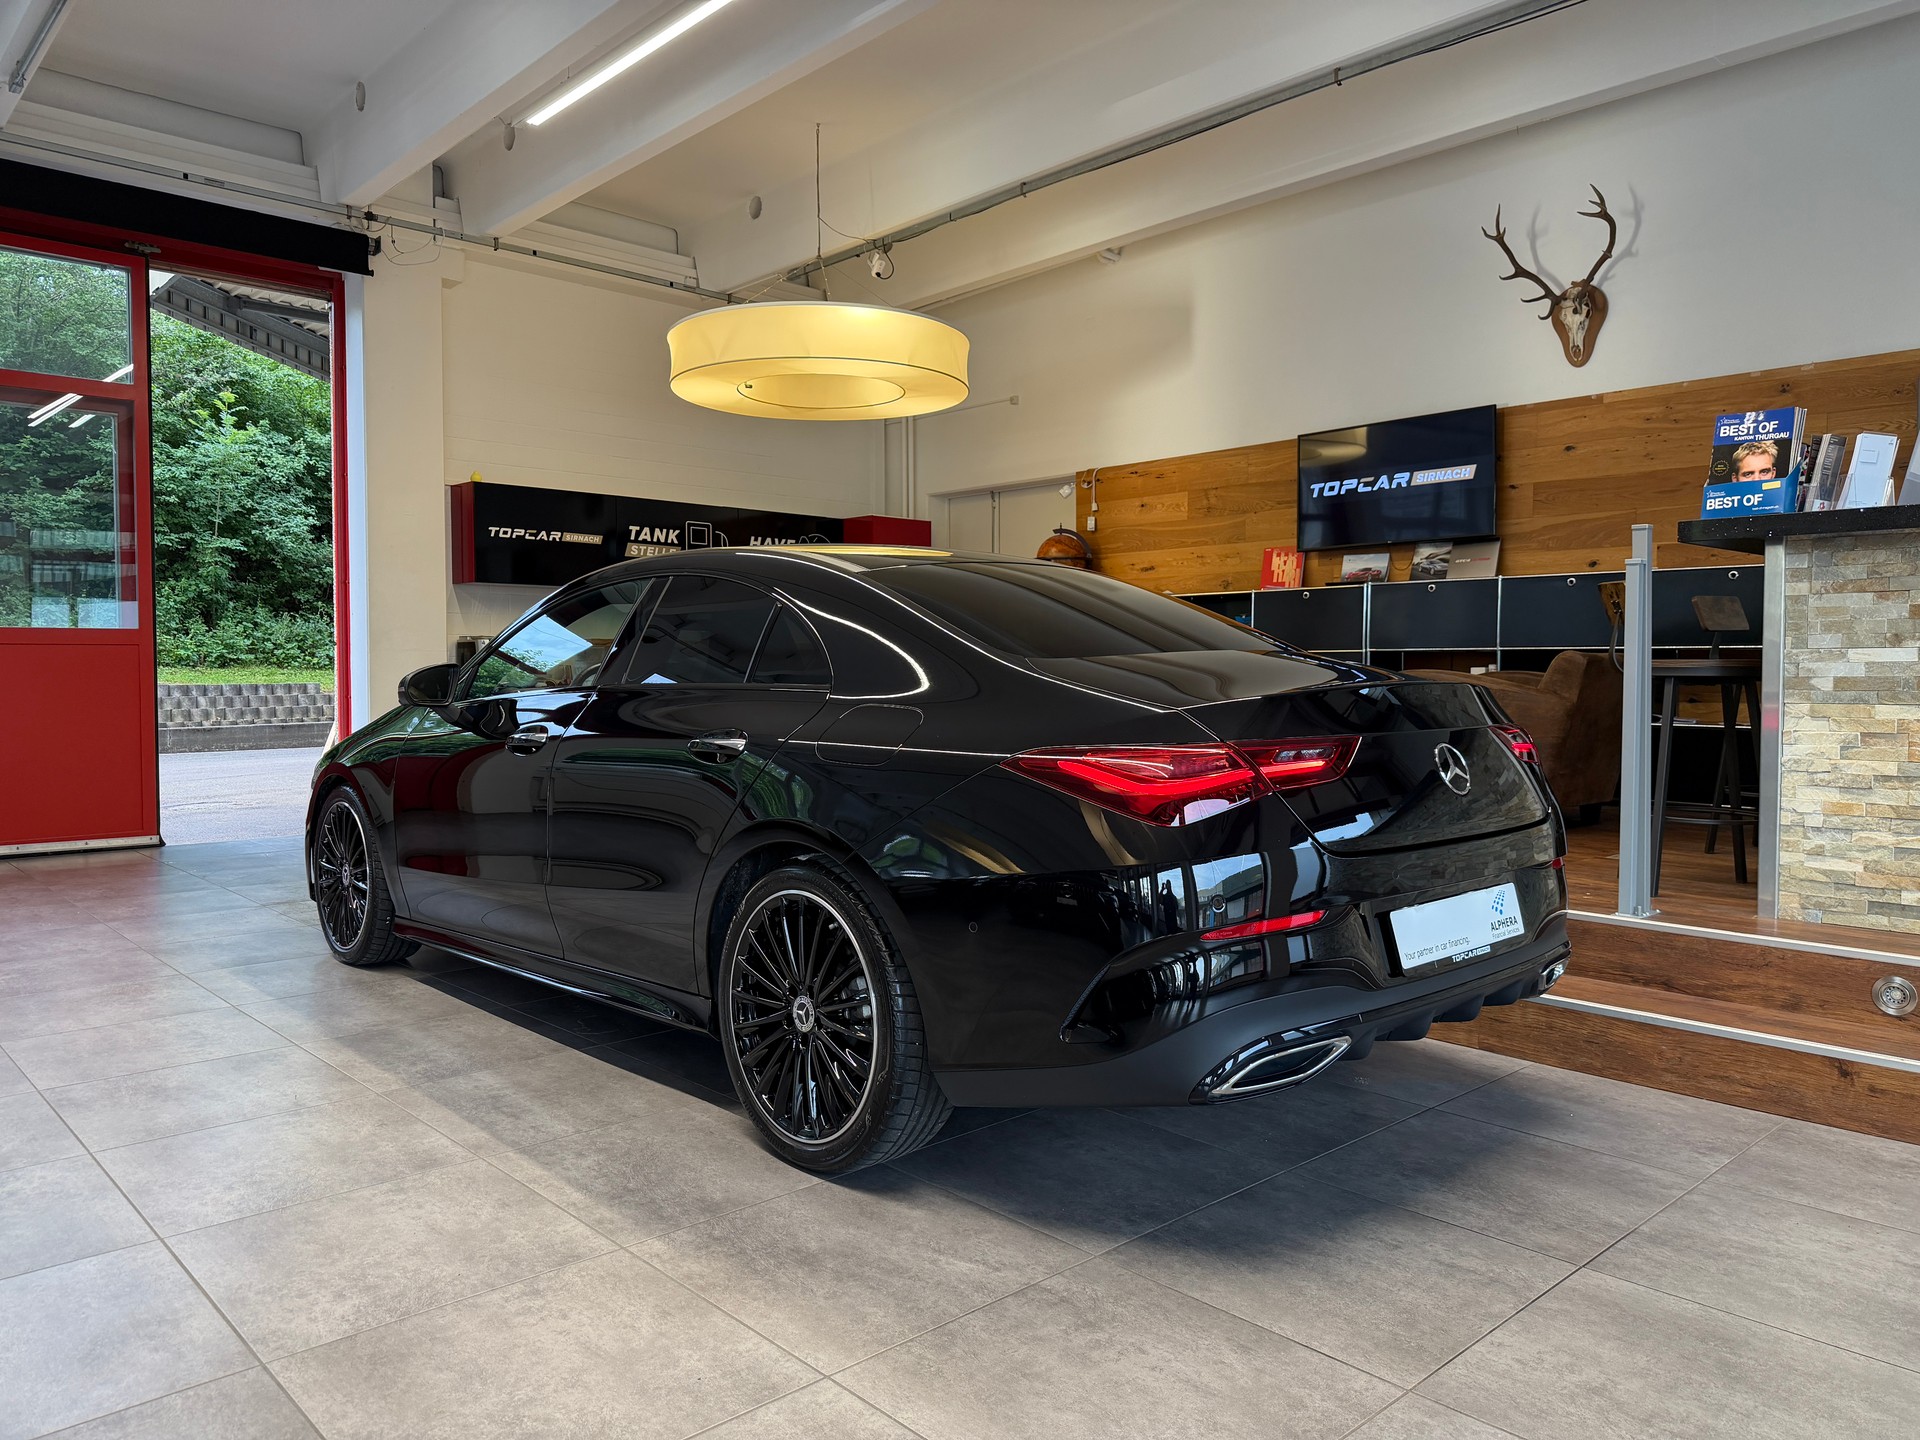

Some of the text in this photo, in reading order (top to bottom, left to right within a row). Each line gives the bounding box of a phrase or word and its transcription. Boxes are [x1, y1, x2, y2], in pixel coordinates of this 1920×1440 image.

[1720, 423, 1757, 437] BEST
[1759, 421, 1779, 433] OF
[1755, 432, 1789, 440] THURGAU
[1310, 467, 1471, 498] TOPCAR SIRNACH
[1706, 493, 1764, 510] BEST OF
[488, 526, 600, 543] TOPCAR SIRNACH
[629, 525, 680, 544] TANK
[1491, 915, 1518, 931] ALPHERA
[1404, 951, 1416, 960] Your
[1417, 946, 1433, 959] partner
[1435, 944, 1440, 952] in
[1452, 949, 1477, 962] TOPCAR
